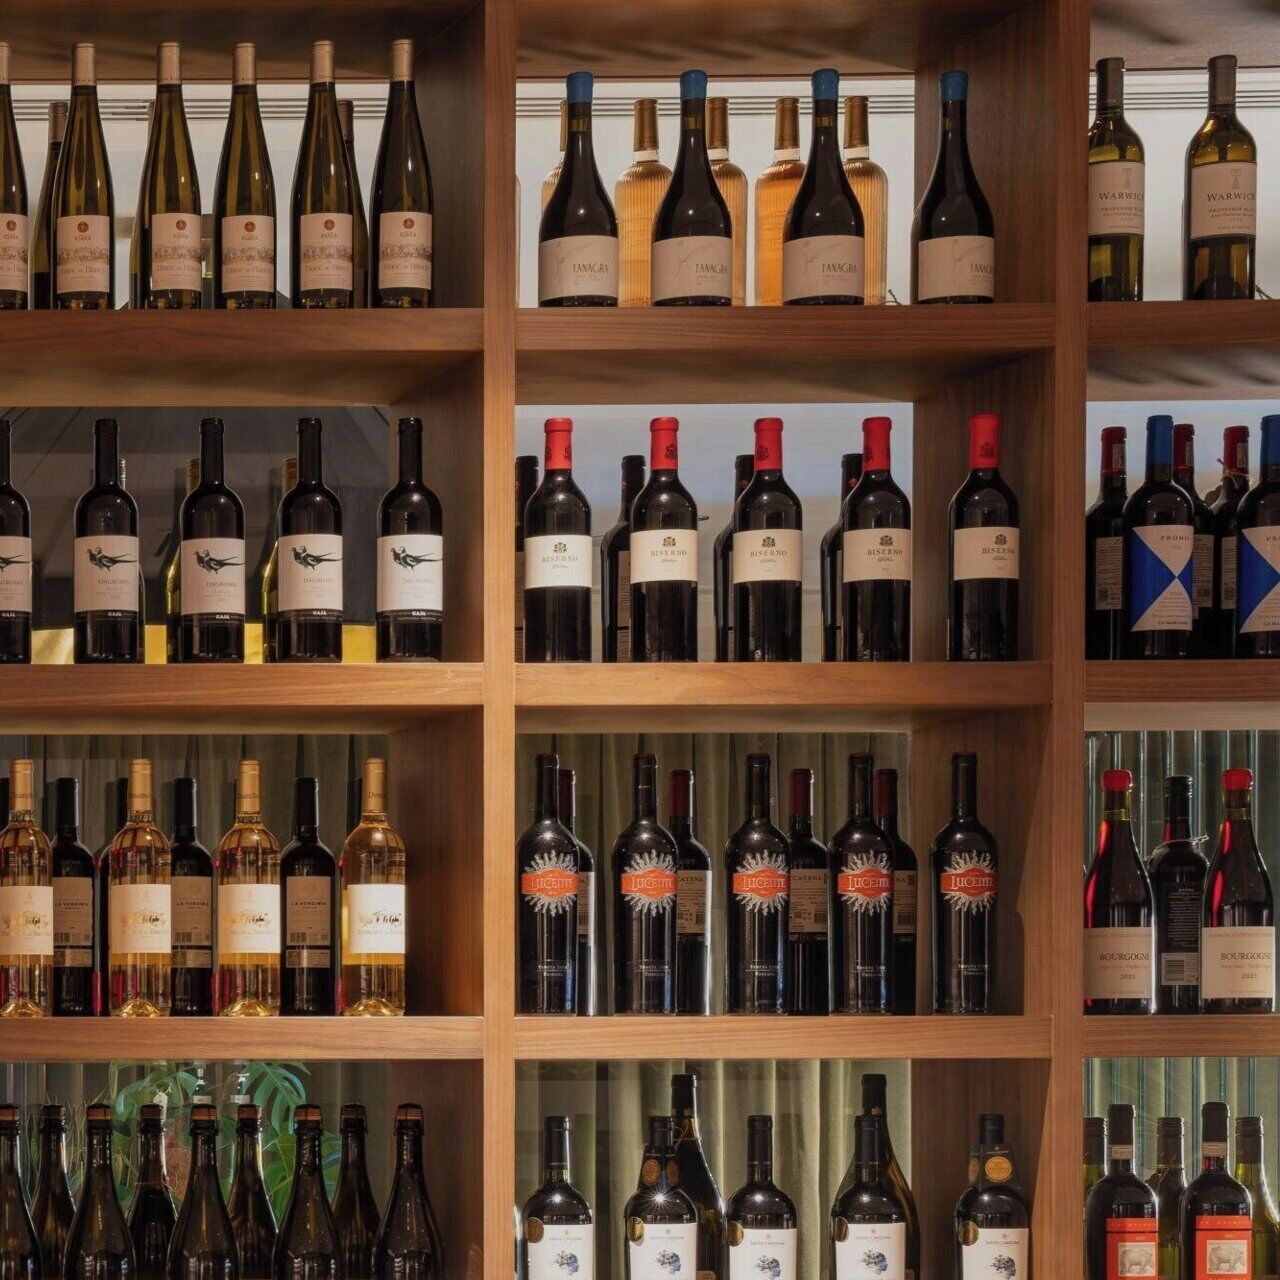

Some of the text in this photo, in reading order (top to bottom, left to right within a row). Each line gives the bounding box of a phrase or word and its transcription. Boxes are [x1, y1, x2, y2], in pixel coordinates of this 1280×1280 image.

[572, 263, 608, 274] TANAGRA
[695, 264, 727, 274] TANAGRA
[821, 263, 857, 273] TANAGRA
